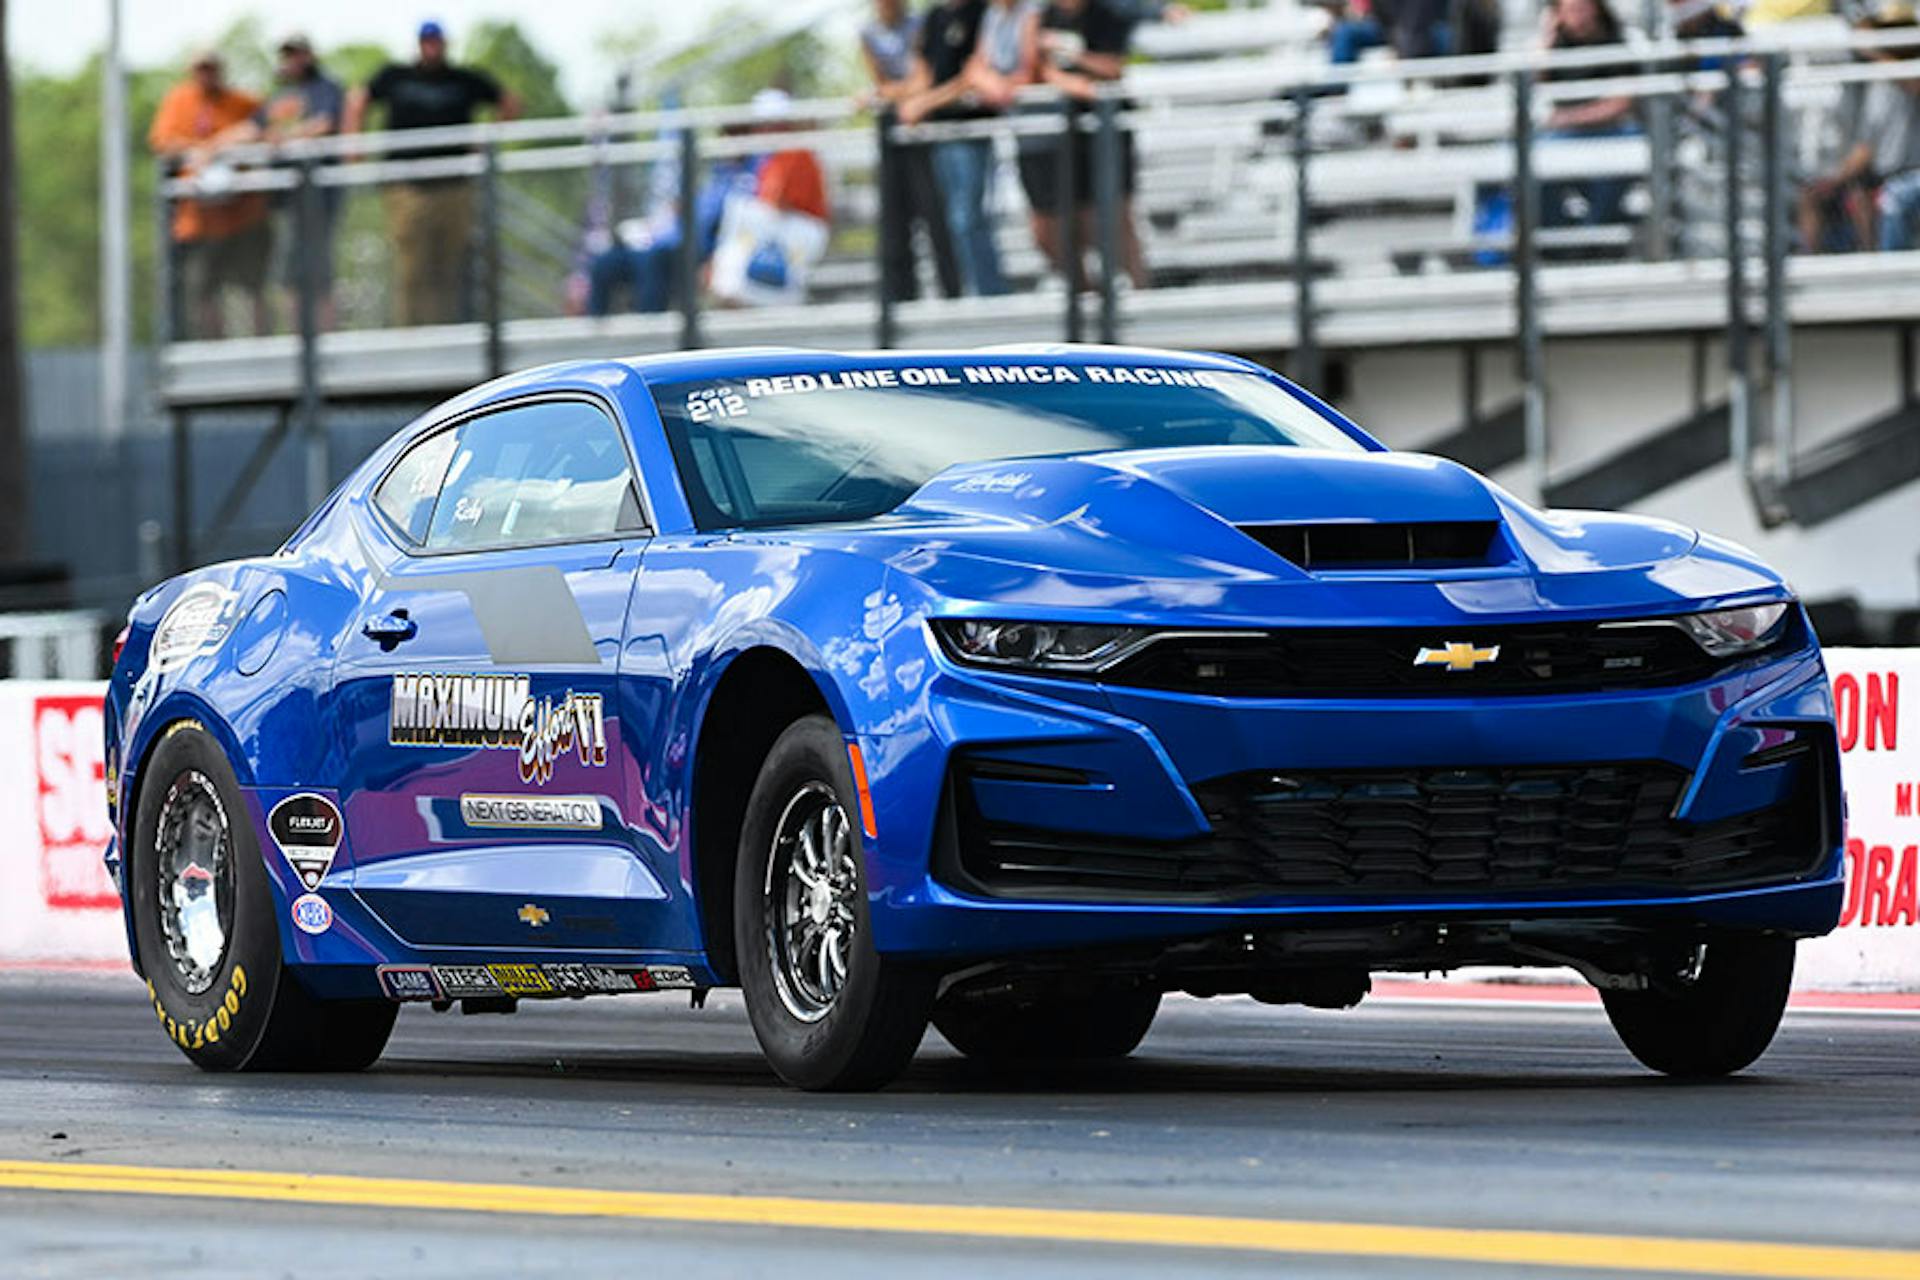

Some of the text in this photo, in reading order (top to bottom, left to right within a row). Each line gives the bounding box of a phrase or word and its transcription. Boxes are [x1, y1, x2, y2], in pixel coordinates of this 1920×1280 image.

[747, 374, 818, 397] RED
[820, 369, 899, 390] LINE
[901, 367, 961, 385] OIL
[963, 366, 1081, 384] NMCA
[686, 394, 749, 423] 212
[390, 672, 531, 748] MAXIMUM
[518, 688, 607, 786] Effort VI
[465, 800, 597, 823] NEXT GENERATION
[1840, 837, 1920, 927] DRA
